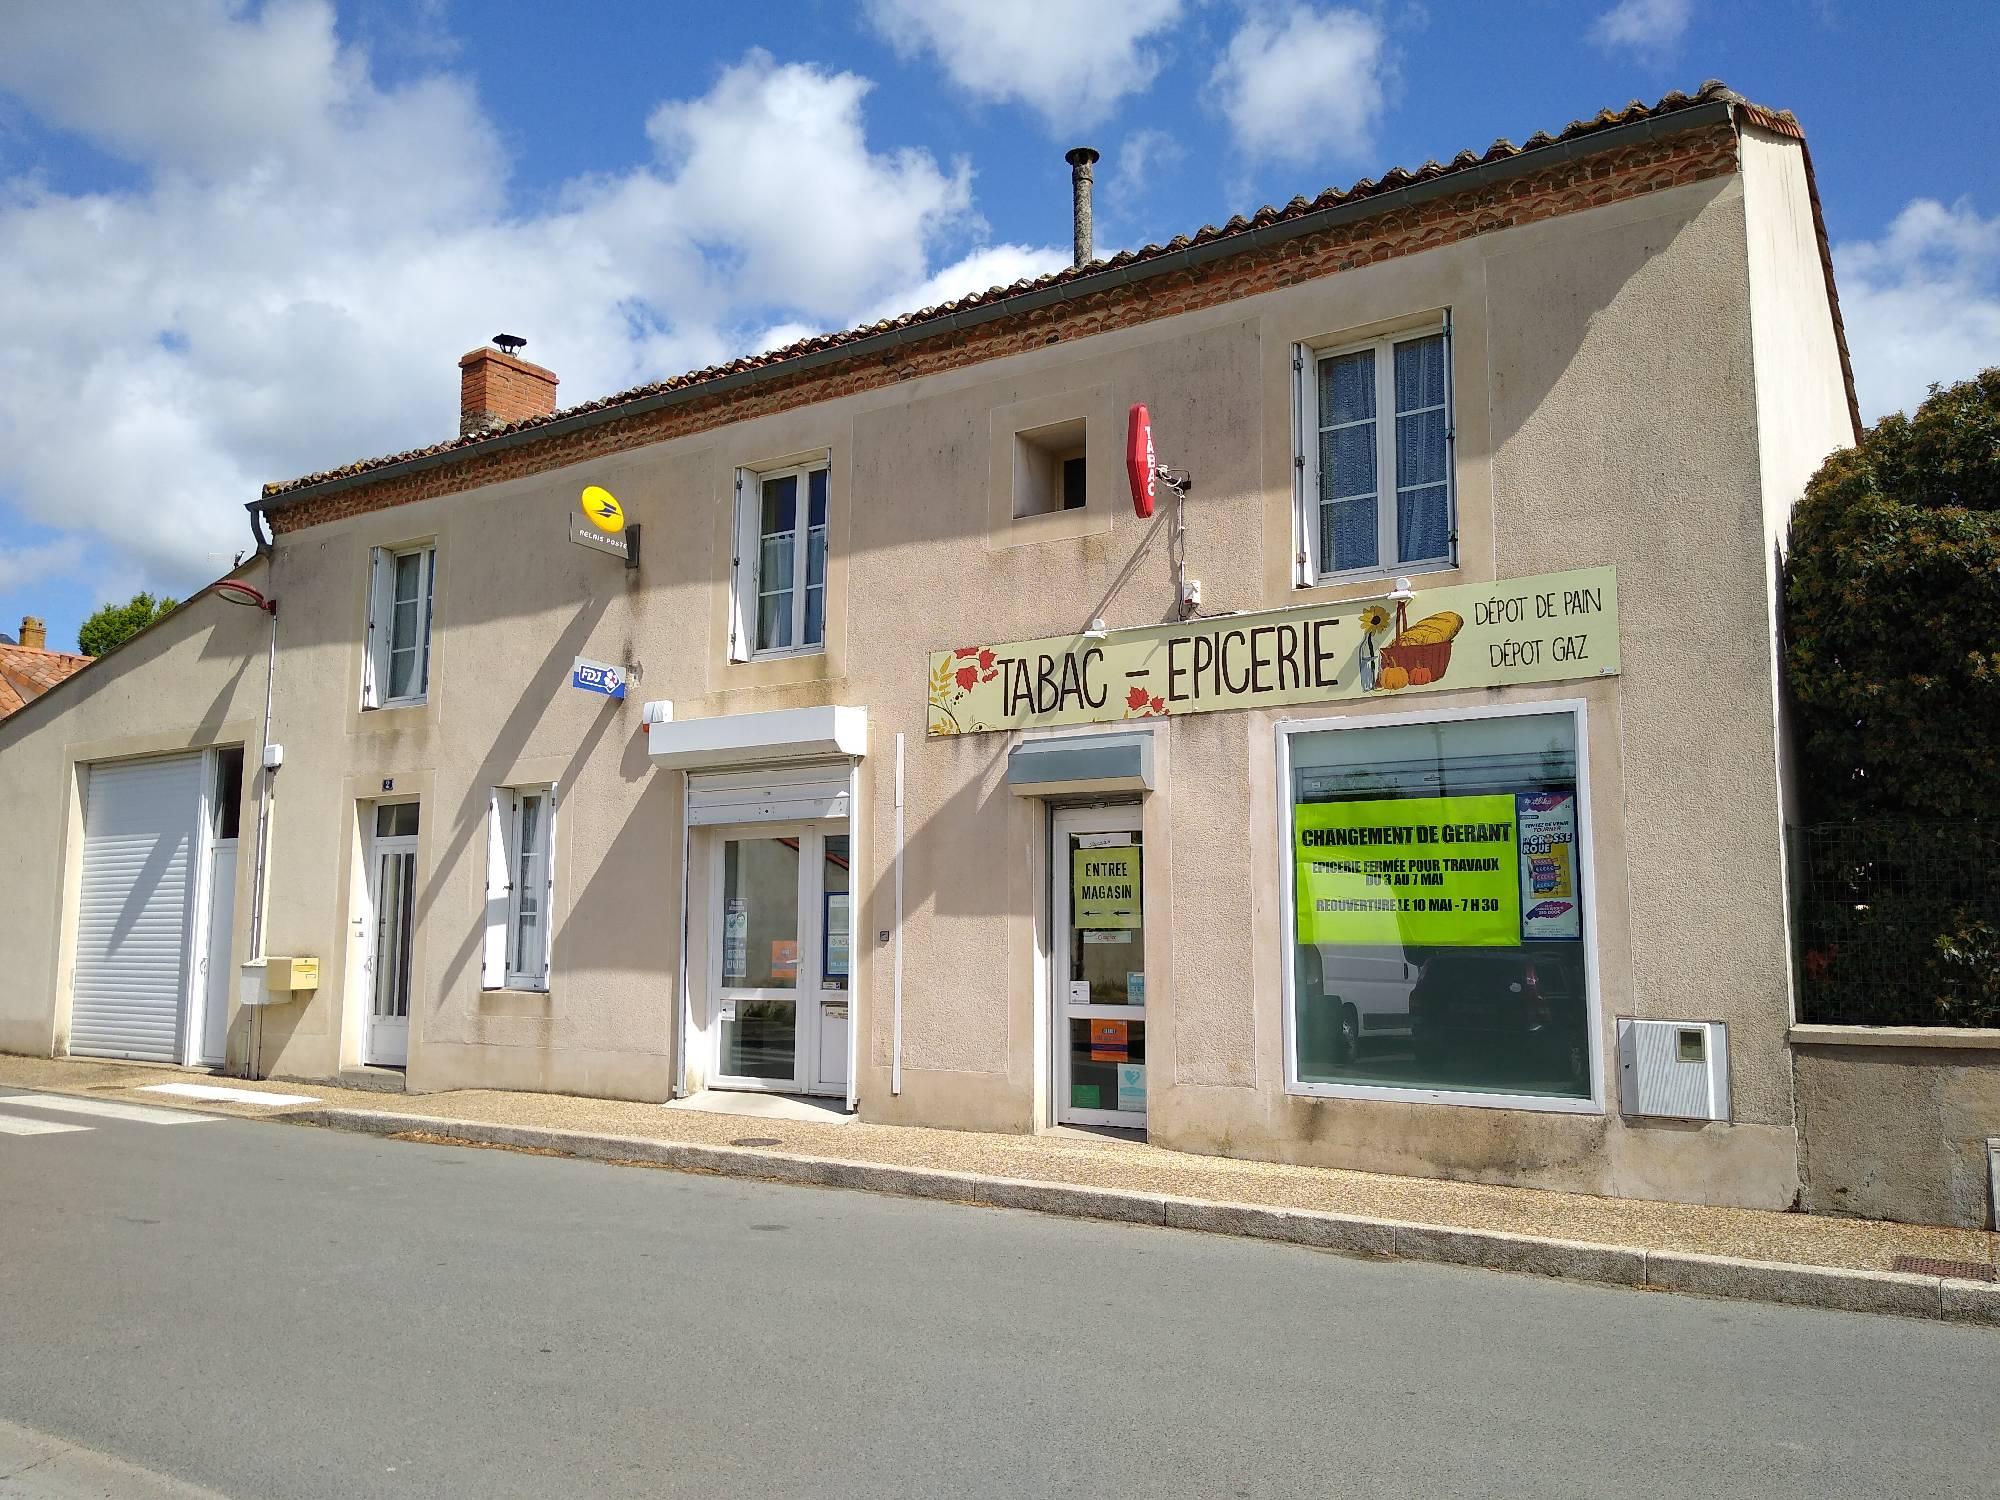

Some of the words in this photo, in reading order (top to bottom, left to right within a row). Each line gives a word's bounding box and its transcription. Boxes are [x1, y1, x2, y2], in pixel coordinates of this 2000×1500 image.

[1144, 426, 1155, 496] TABAC
[579, 530, 604, 542] RELAIS
[606, 538, 628, 550] POSTE
[1474, 596, 1528, 626] DÉPOT
[1535, 592, 1557, 619] DE
[1564, 587, 1602, 615] PAIN
[1489, 639, 1543, 668] DÉPOT
[1552, 634, 1589, 662] GAZ
[581, 668, 602, 683] FDJ
[996, 648, 1108, 717] TABAC
[1168, 618, 1340, 702] EPICERIE
[1302, 825, 1414, 847] CHANGEMENT
[1416, 823, 1438, 844] DE
[1441, 821, 1513, 843] GERANT
[1523, 843, 1551, 855] ROUE
[1085, 862, 1128, 877] ENTREE
[1312, 861, 1361, 874] EPICERIE
[1363, 857, 1406, 873] FERMÉE
[1408, 859, 1441, 873] POUR
[1442, 857, 1500, 872] TRAVAUX
[1366, 873, 1382, 886] DU
[1383, 873, 1392, 886] 3
[1394, 873, 1410, 886] AU
[1412, 873, 1418, 886] 7
[1420, 873, 1444, 886] MAI
[1081, 885, 1132, 900] MAGASIN
[1398, 899, 1410, 912] LE
[1412, 899, 1425, 912] 10
[1428, 899, 1453, 912] MAI
[1462, 899, 1468, 912] 7
[1470, 899, 1480, 912] H
[1481, 899, 1499, 912] 30
